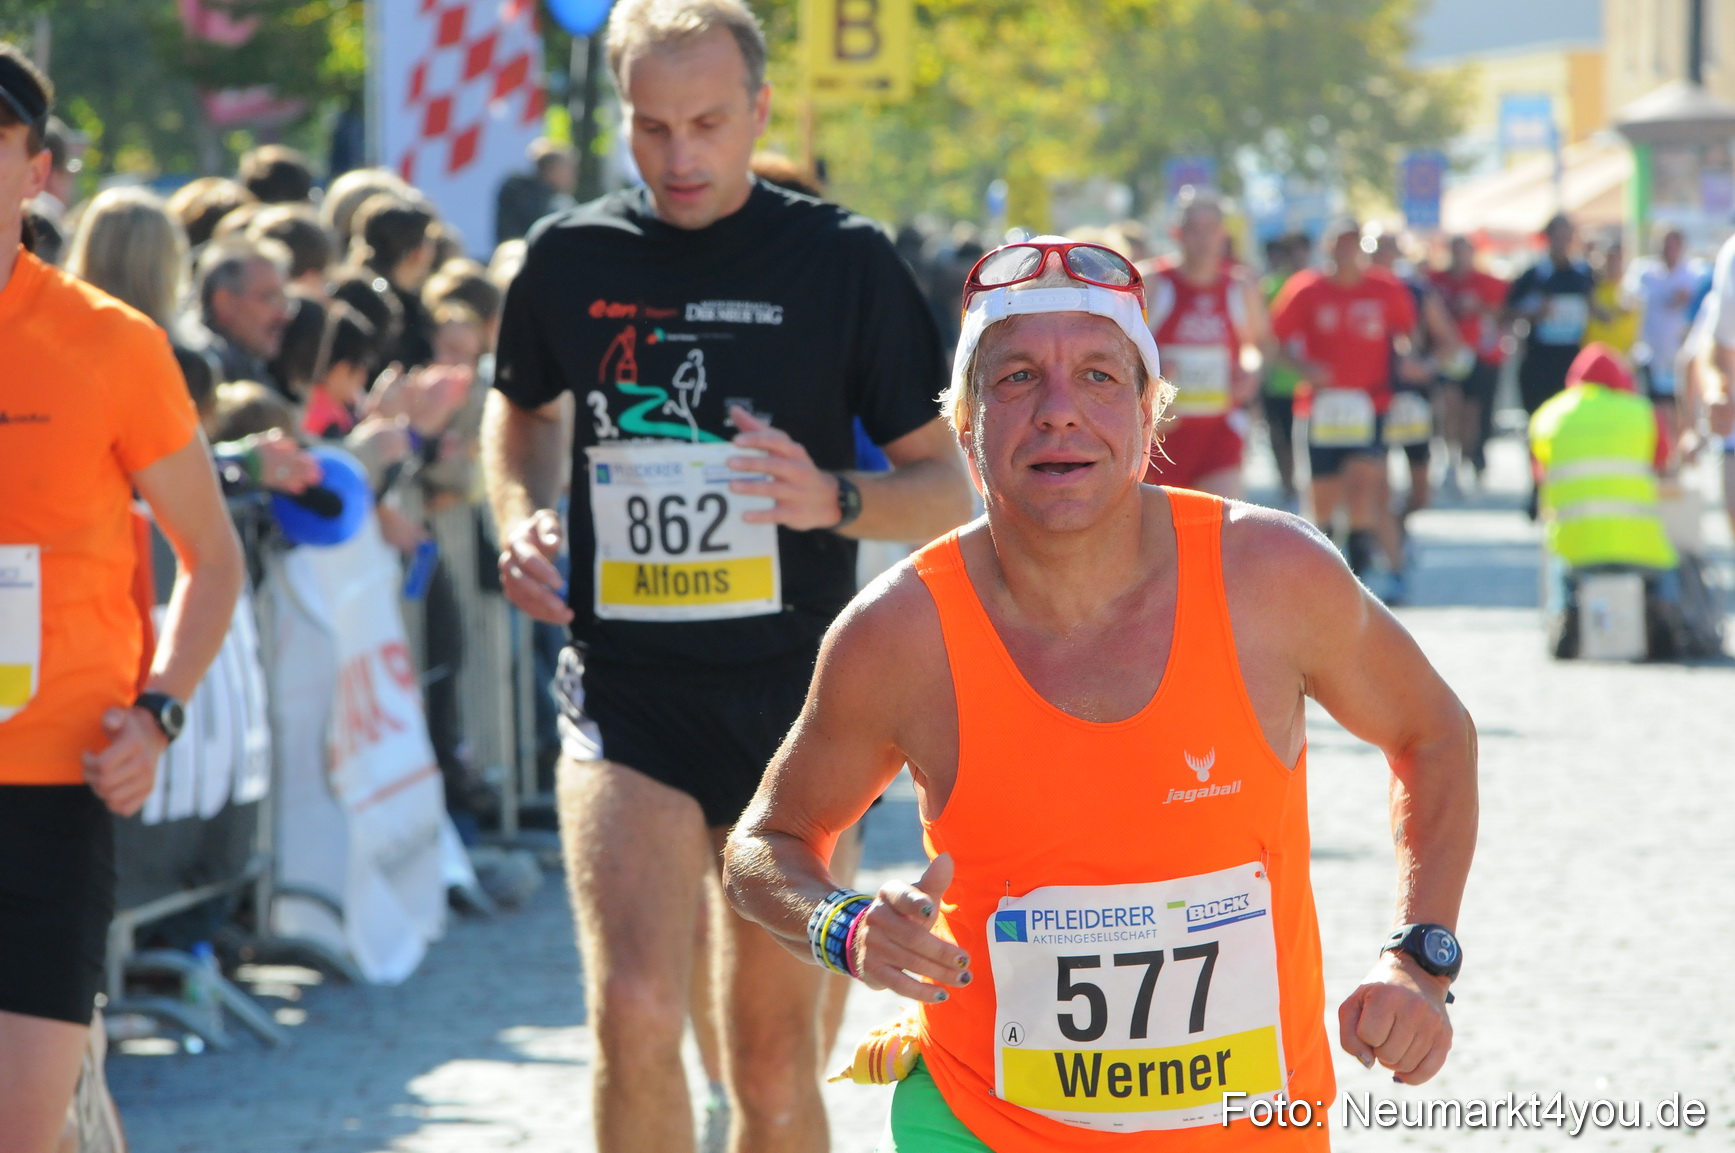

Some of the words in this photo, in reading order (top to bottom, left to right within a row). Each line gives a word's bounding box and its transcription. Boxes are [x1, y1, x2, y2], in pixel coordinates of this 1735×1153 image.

[834, 0, 882, 62] B
[627, 493, 731, 555] 862
[634, 563, 731, 596] Alfons
[1162, 779, 1242, 804] jagaball
[1031, 905, 1156, 931] PFLEIDERER
[1186, 892, 1249, 922] BOCK
[1032, 928, 1158, 945] AKTIENGESELLSCHAFT
[1056, 940, 1219, 1043] 577
[1008, 1026, 1018, 1042] A
[1054, 1048, 1232, 1099] Werner
